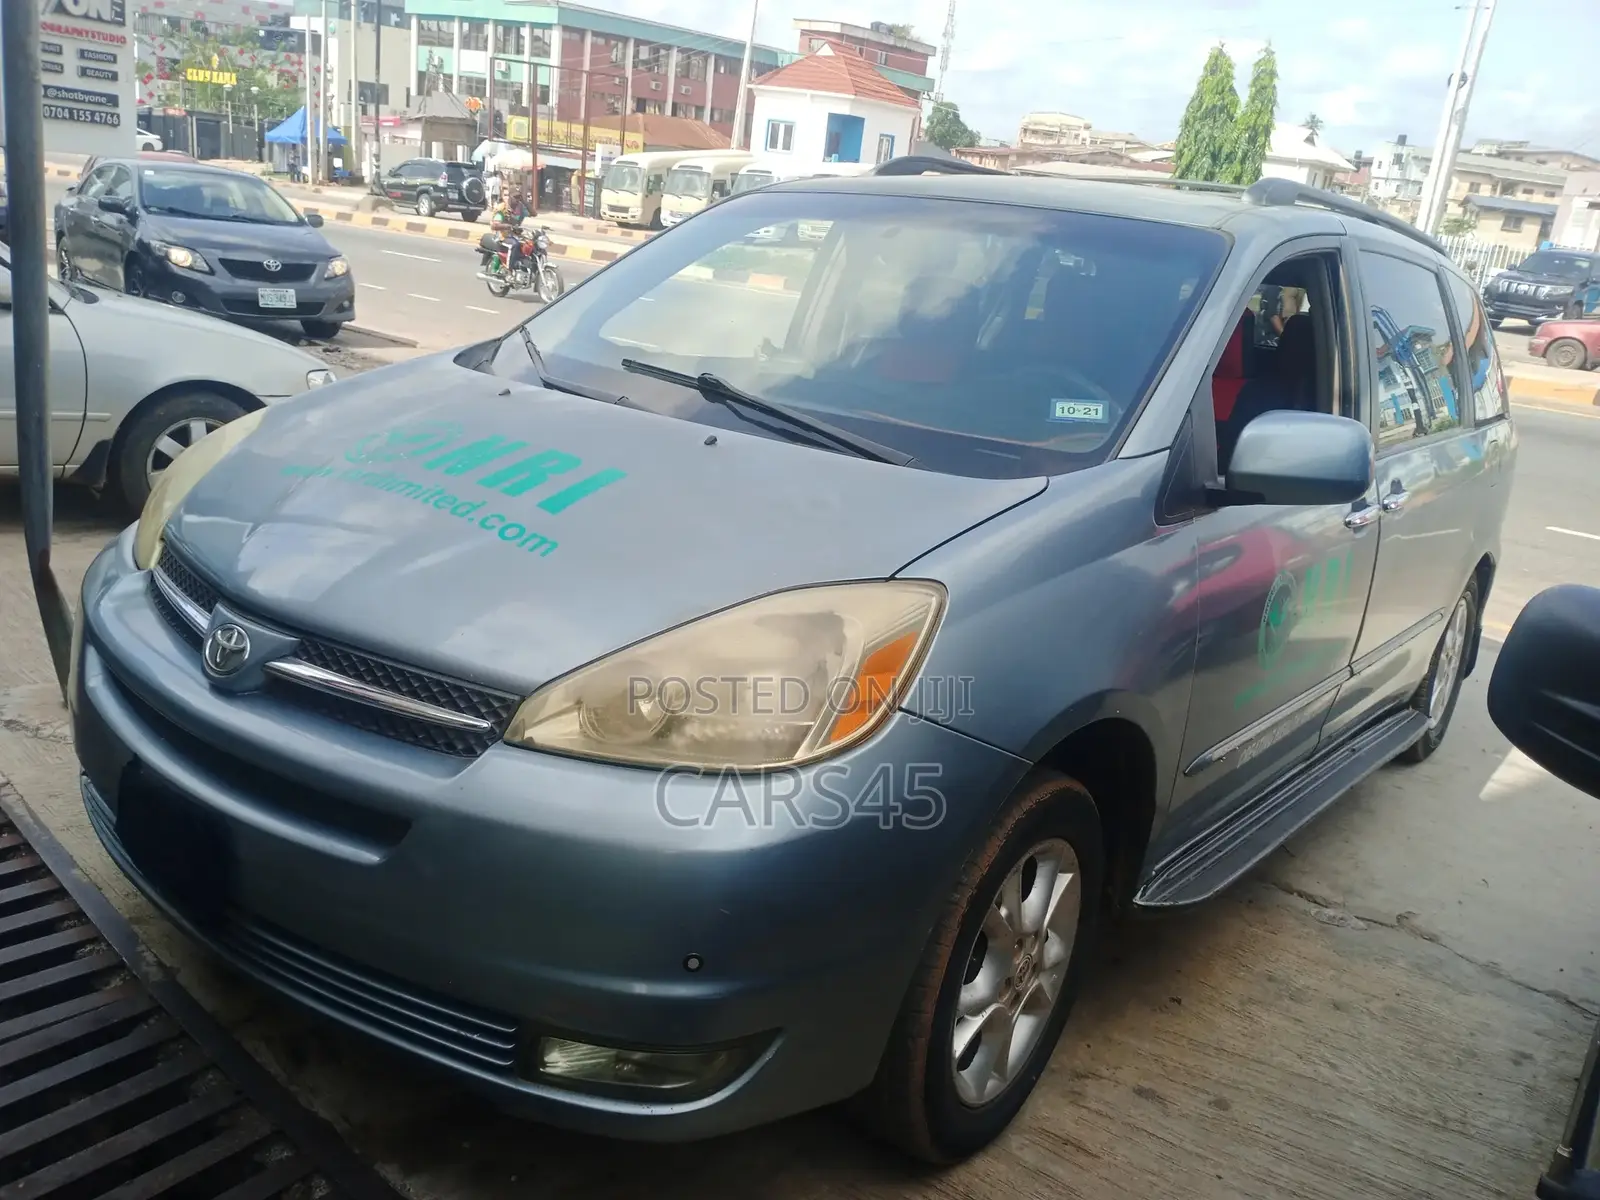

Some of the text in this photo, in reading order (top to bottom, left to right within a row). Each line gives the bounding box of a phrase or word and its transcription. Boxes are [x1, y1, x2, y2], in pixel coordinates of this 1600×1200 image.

[84, 50, 114, 62] FASHION
[86, 68, 113, 79] BEAUTY
[43, 106, 119, 125] 0704 155 4766
[422, 434, 628, 516] NRI
